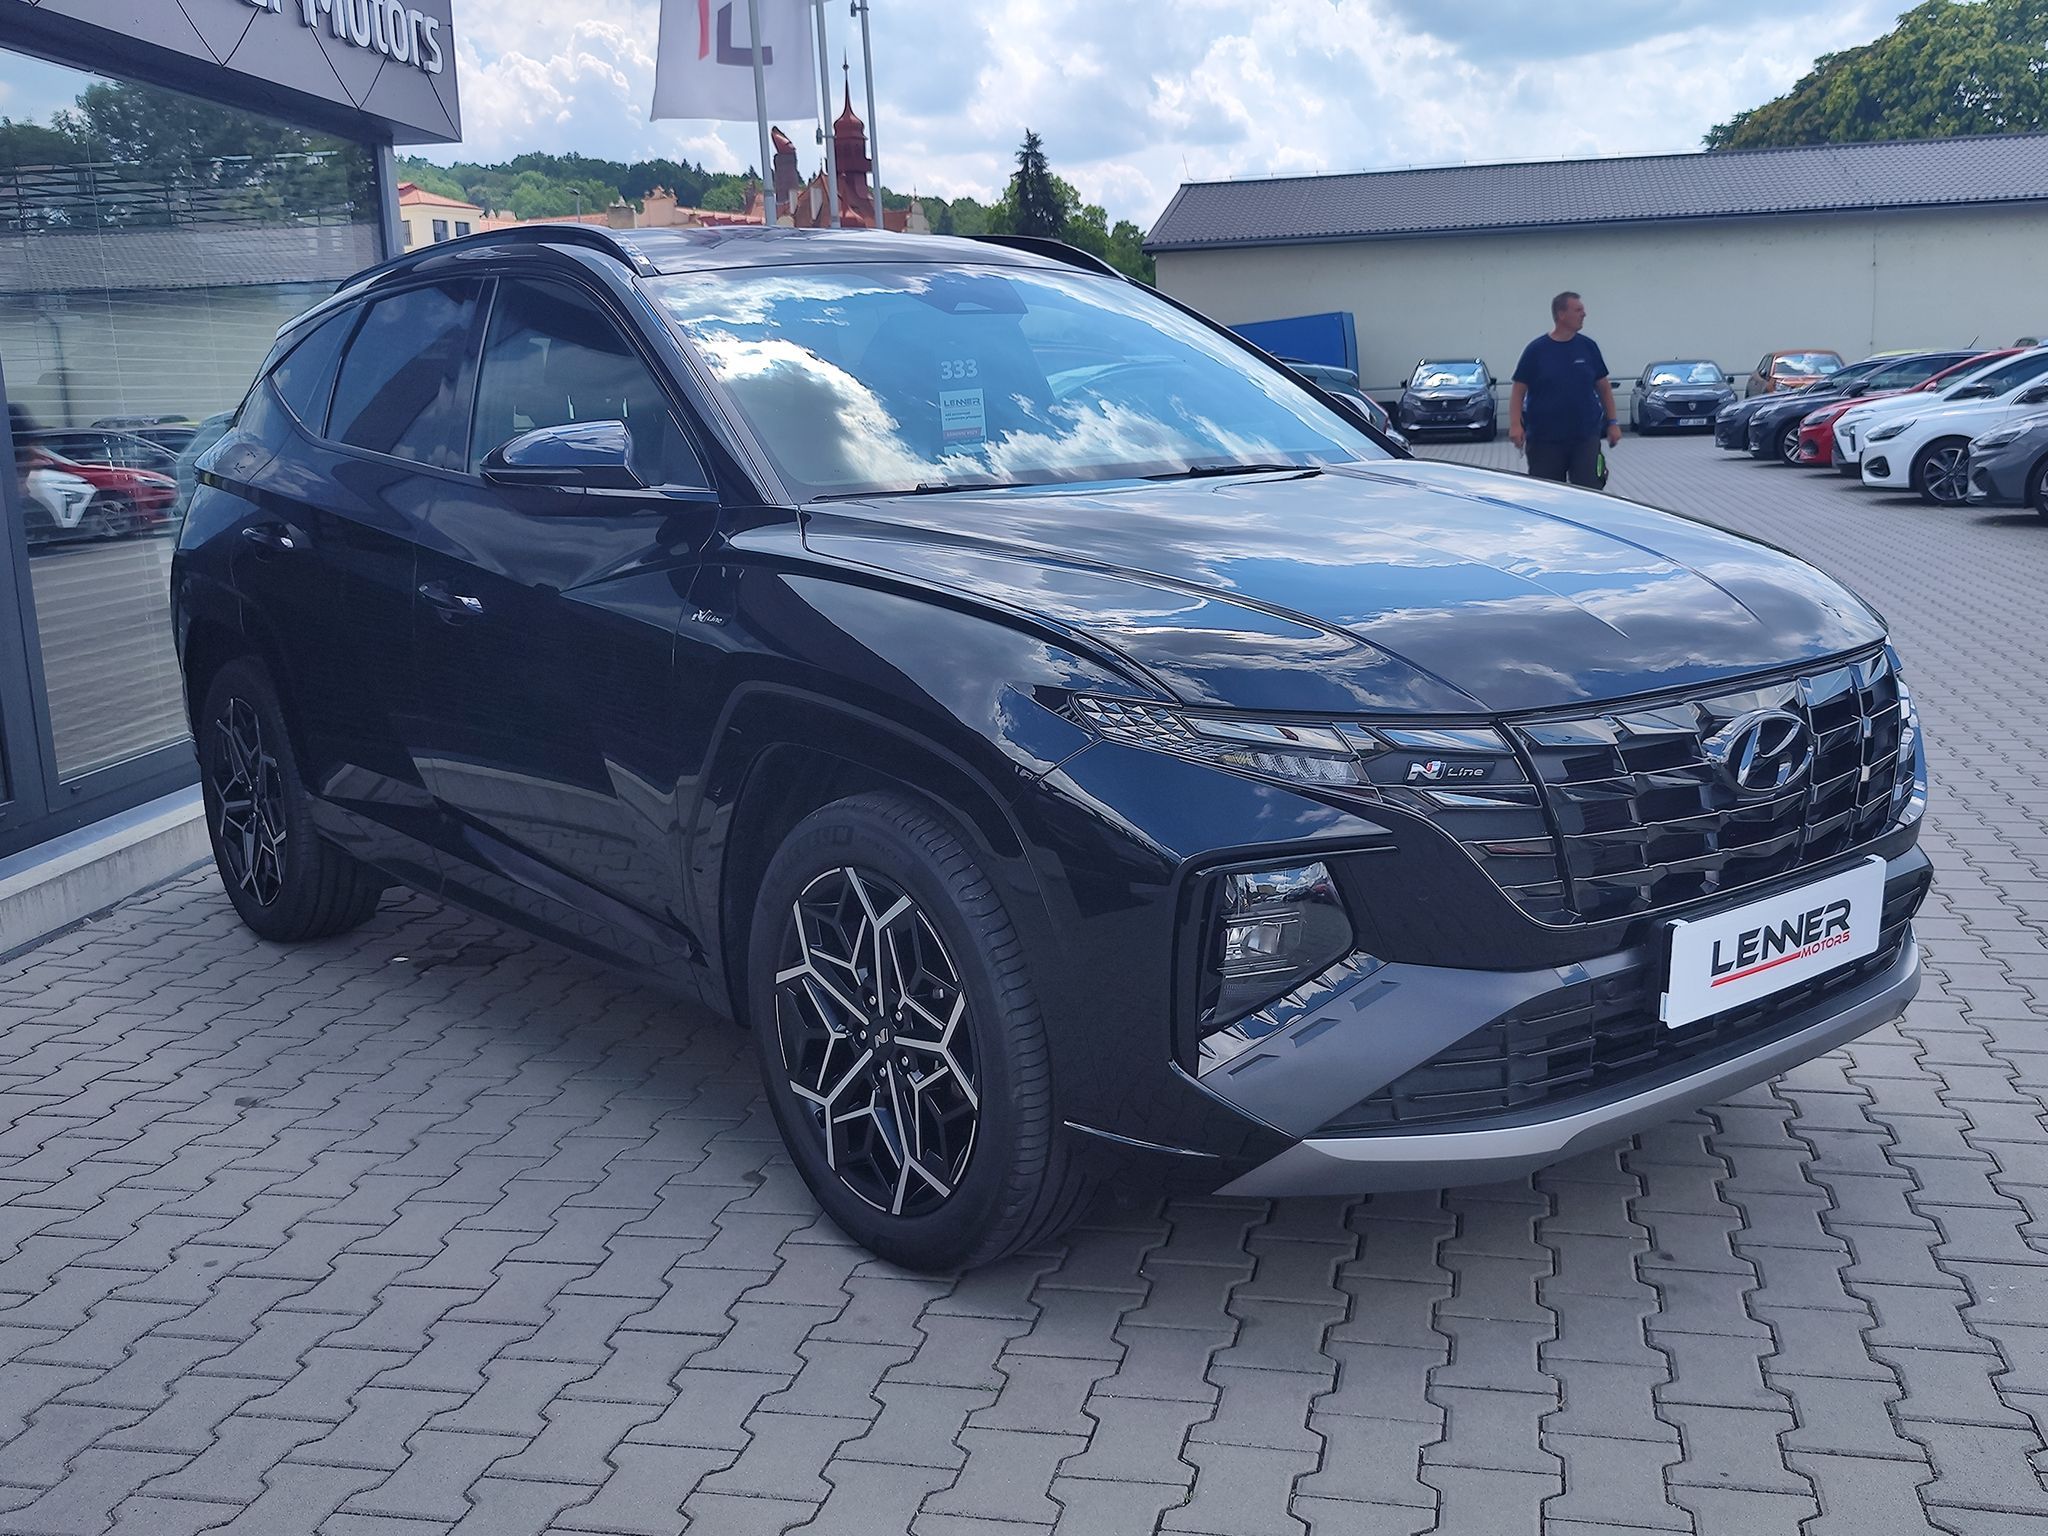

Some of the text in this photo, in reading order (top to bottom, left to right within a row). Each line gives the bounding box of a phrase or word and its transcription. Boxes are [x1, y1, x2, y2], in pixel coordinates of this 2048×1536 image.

[940, 359, 978, 380] 333
[1447, 767, 1485, 777] Line
[1710, 898, 1852, 977] LENNER
[1800, 930, 1851, 960] MOTORS
